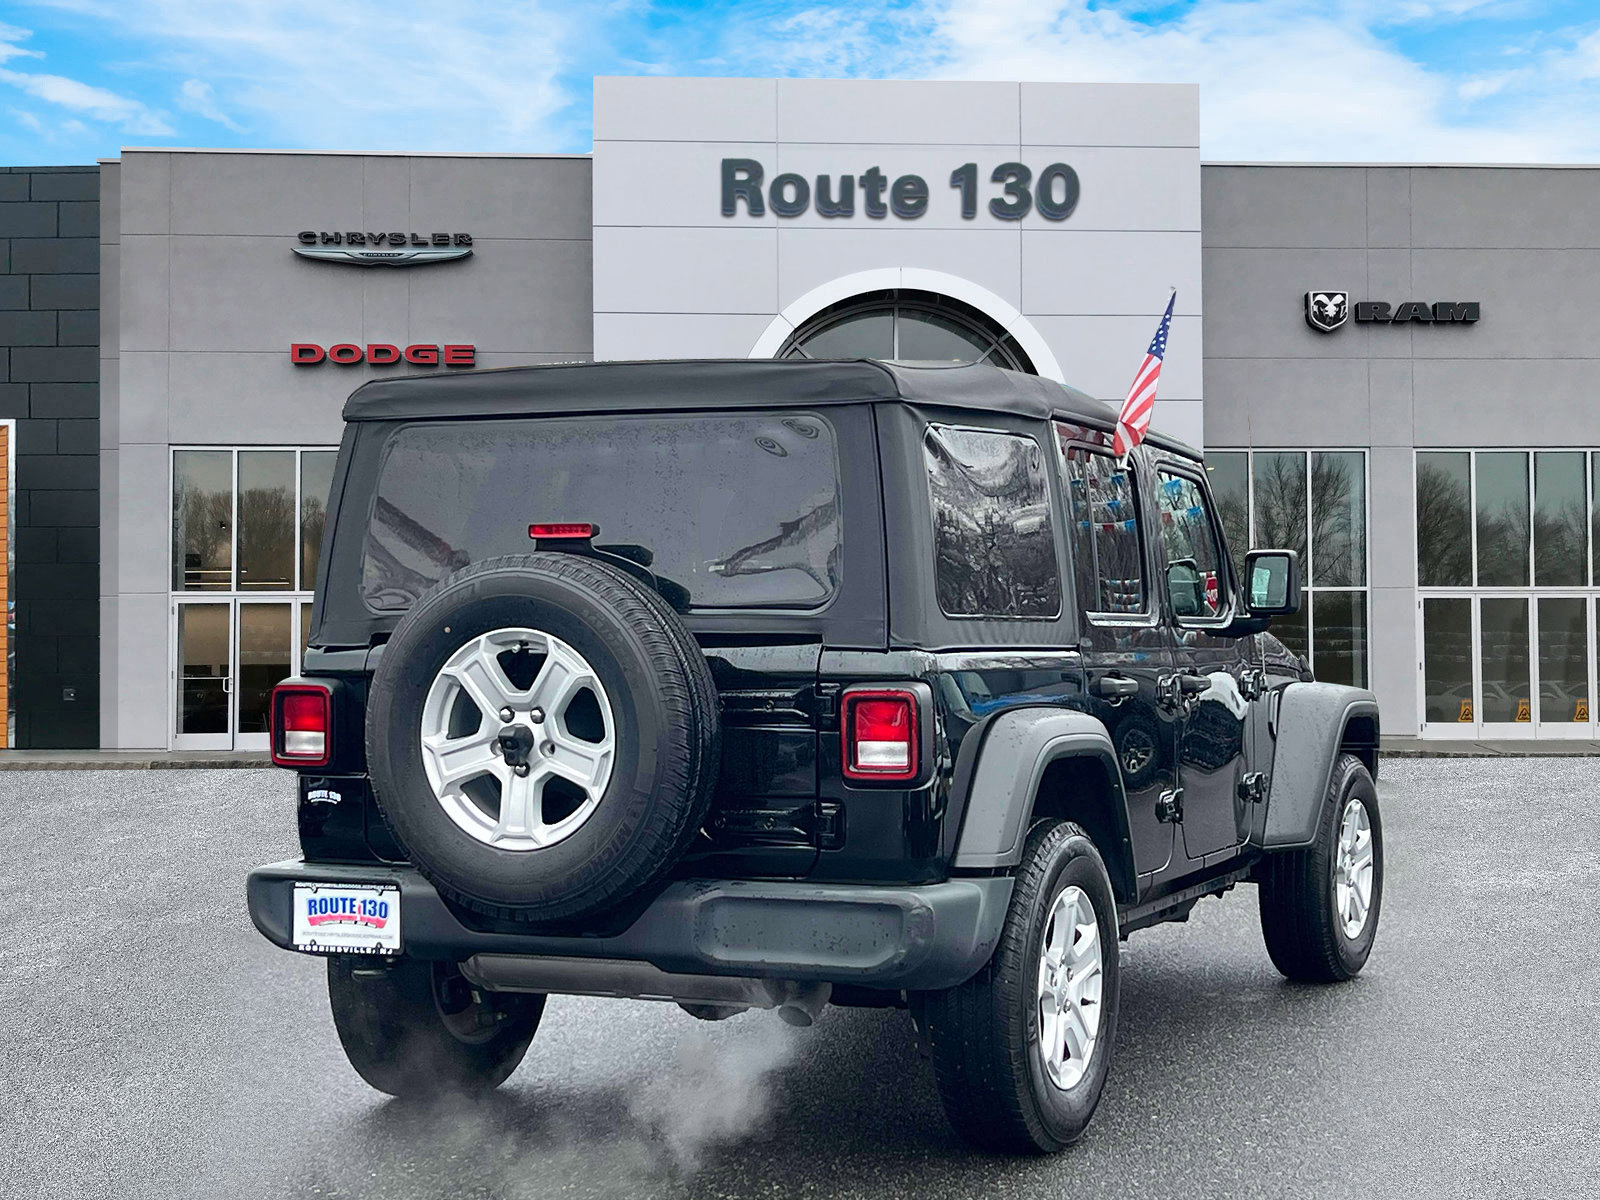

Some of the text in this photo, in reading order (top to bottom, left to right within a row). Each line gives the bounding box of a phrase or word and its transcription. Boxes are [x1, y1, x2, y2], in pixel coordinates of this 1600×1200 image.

[721, 158, 1081, 220] Route 130
[298, 231, 473, 246] CHRYSLER
[1354, 302, 1481, 323] RAM
[291, 343, 476, 366] DODGE
[307, 897, 389, 919] ROUTE 130
